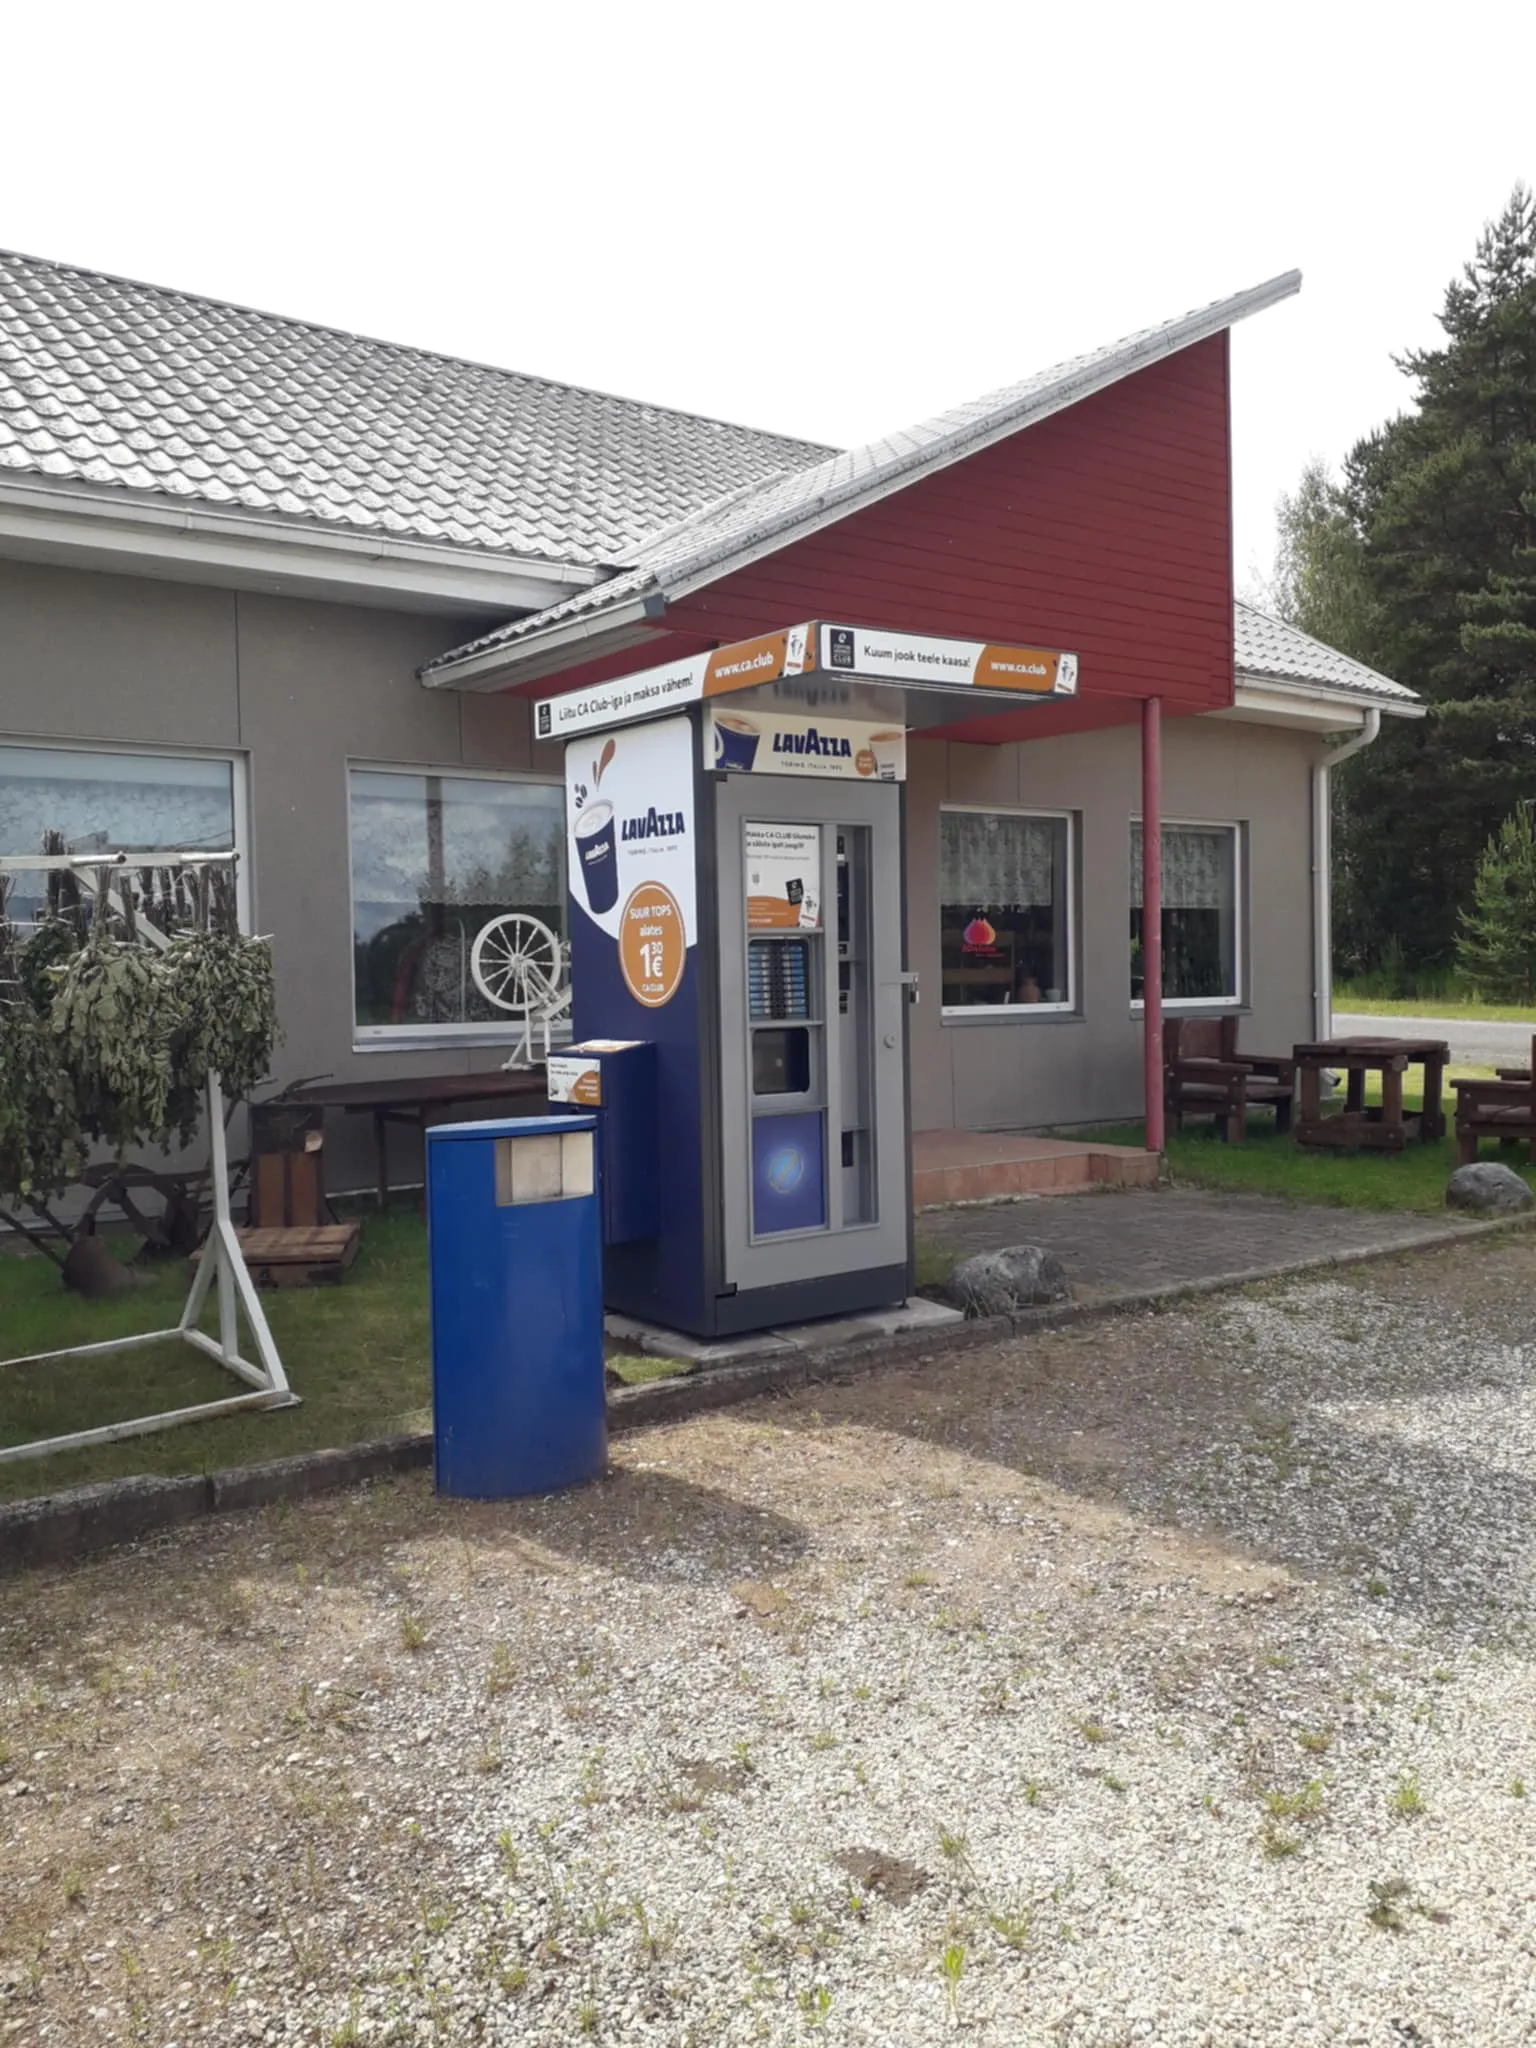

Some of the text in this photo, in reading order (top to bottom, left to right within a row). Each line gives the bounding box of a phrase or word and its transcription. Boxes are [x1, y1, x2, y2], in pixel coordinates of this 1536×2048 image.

[714, 650, 774, 678] www.ca.club
[864, 645, 893, 658] Kuum
[894, 647, 915, 662] jook
[917, 652, 940, 665] teele
[942, 655, 971, 668] kaasa!
[990, 660, 1047, 676] www.ca.club
[558, 672, 694, 721] Liitu CA Club-iga ja maksa vähem!
[772, 727, 852, 758] LAVAZZA
[621, 806, 685, 841] LAVAZZA
[629, 904, 672, 920] SUUR TOPS
[640, 924, 663, 937] alates
